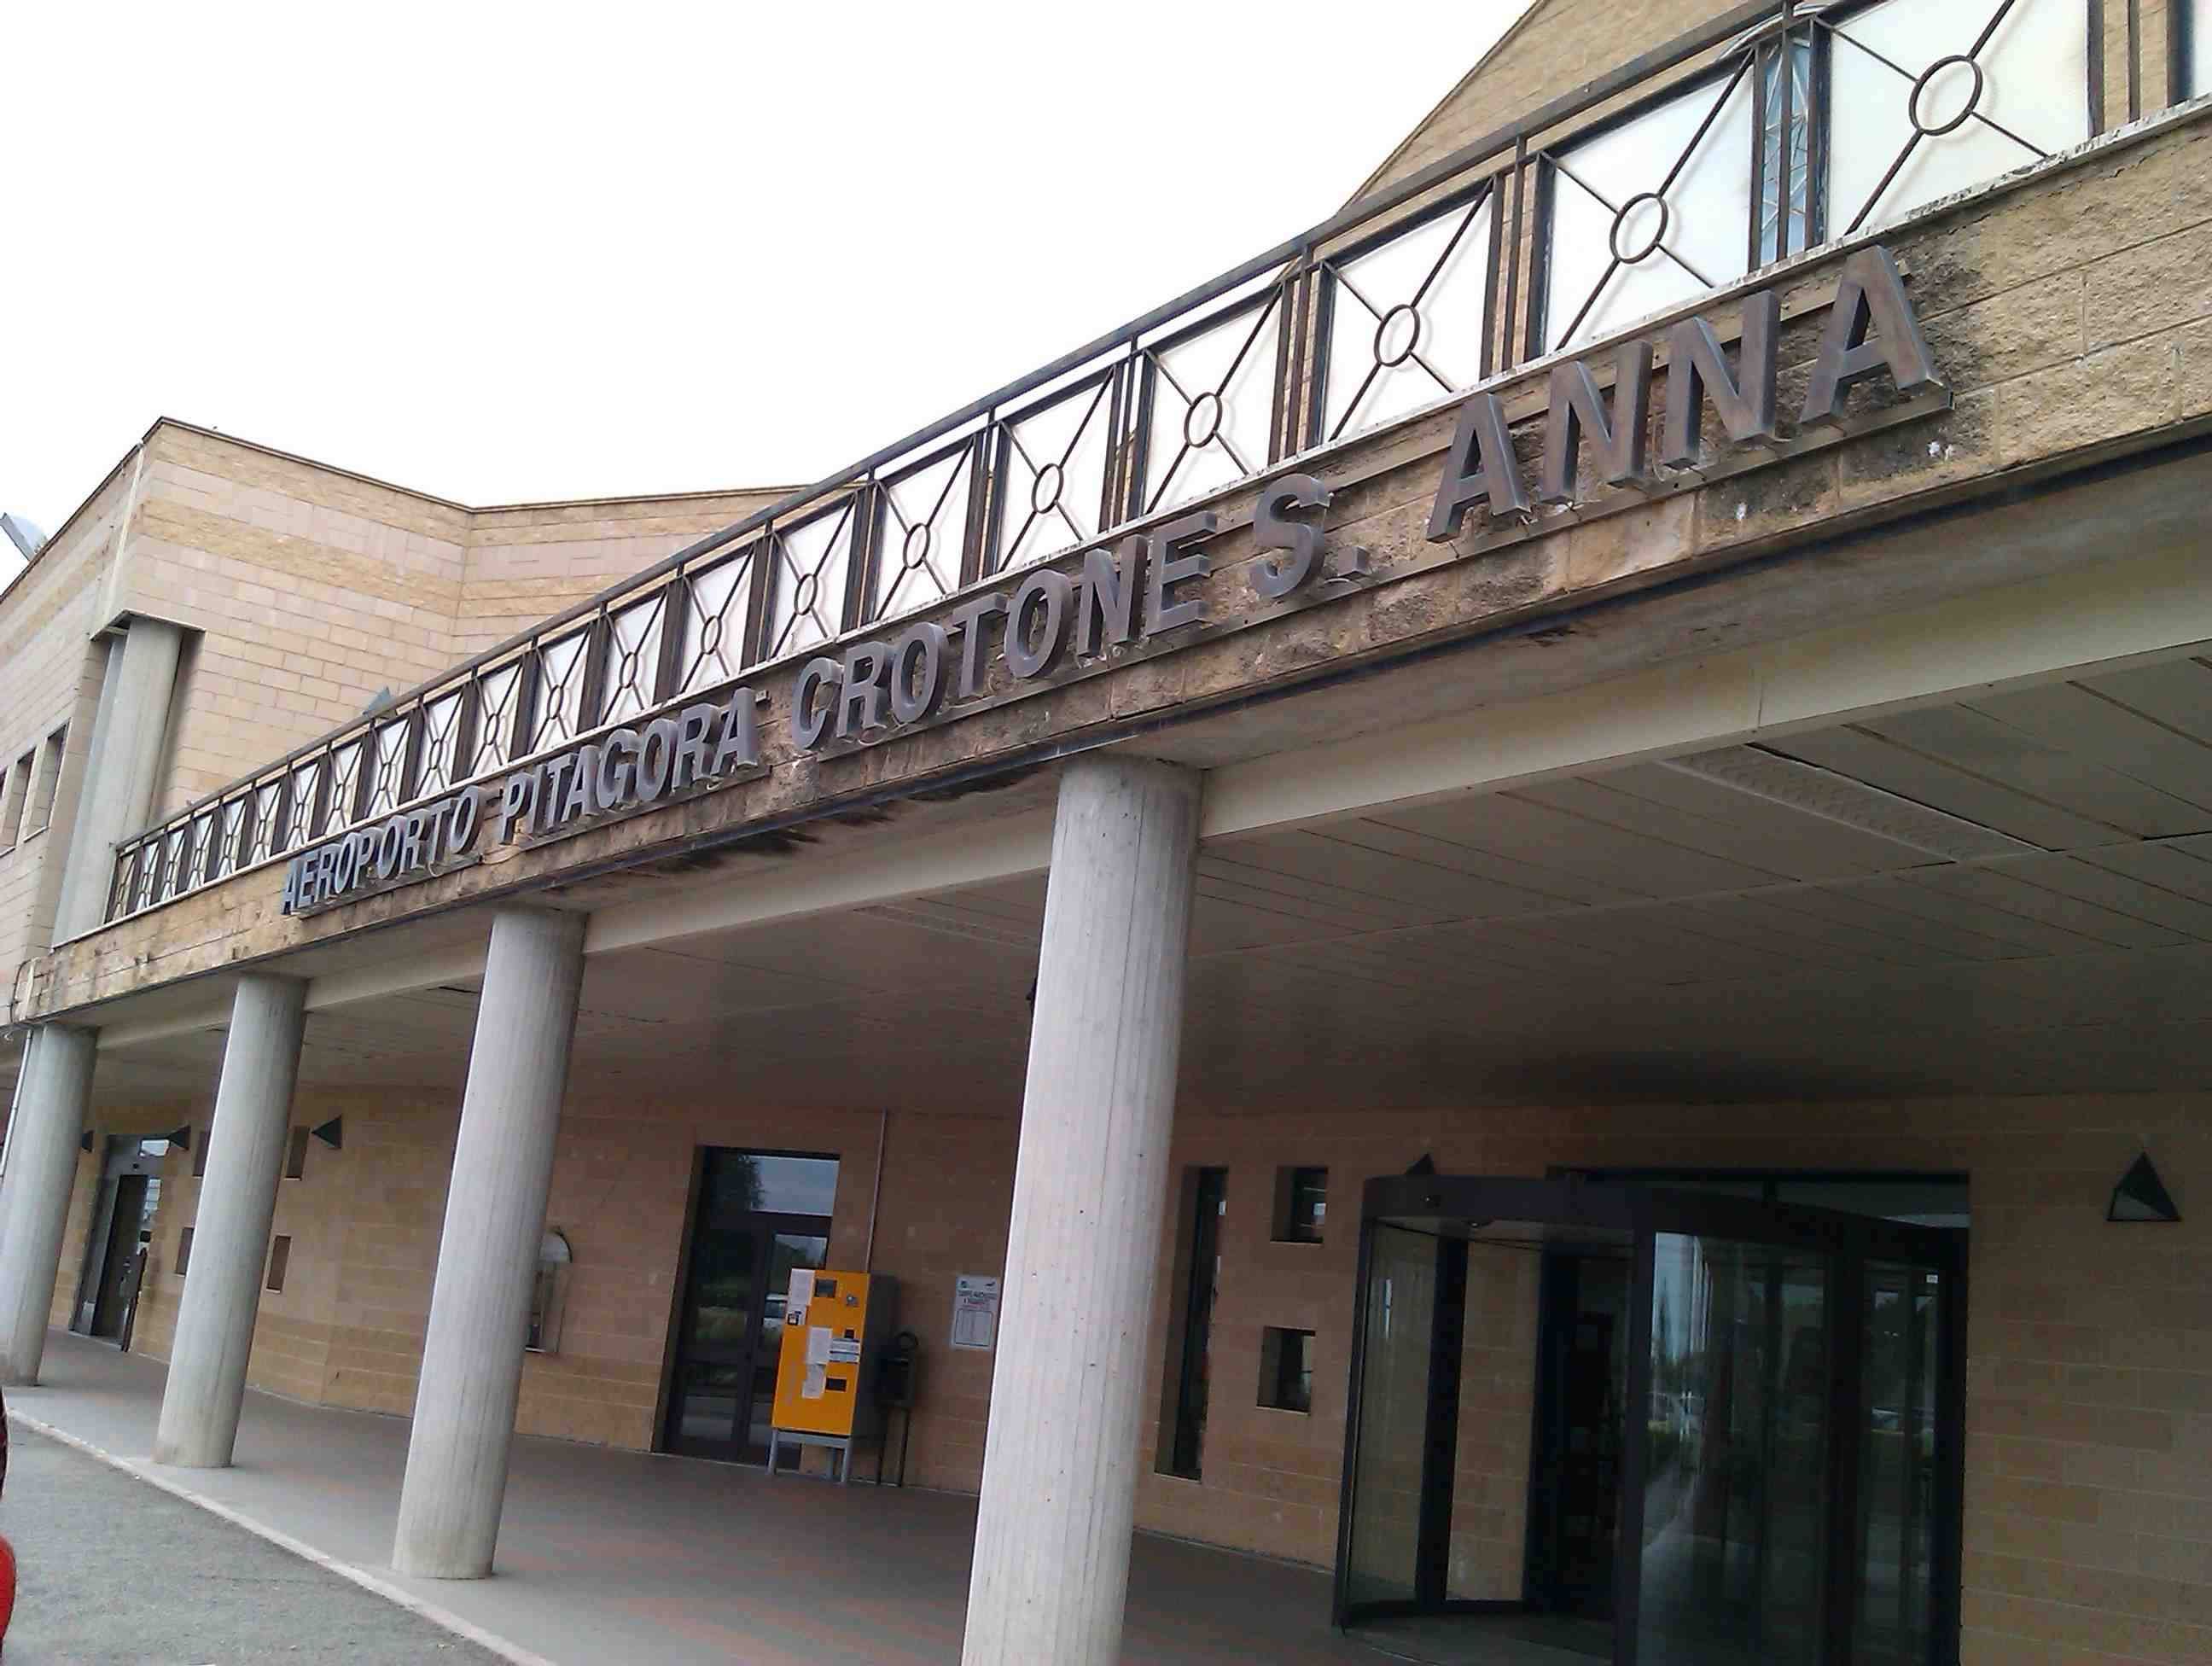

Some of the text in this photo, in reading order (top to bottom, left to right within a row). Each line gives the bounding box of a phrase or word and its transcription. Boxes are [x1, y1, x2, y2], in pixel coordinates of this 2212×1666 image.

[281, 246, 1946, 916] AEROPORTO PITAGORA CROTONE S. ANNA
